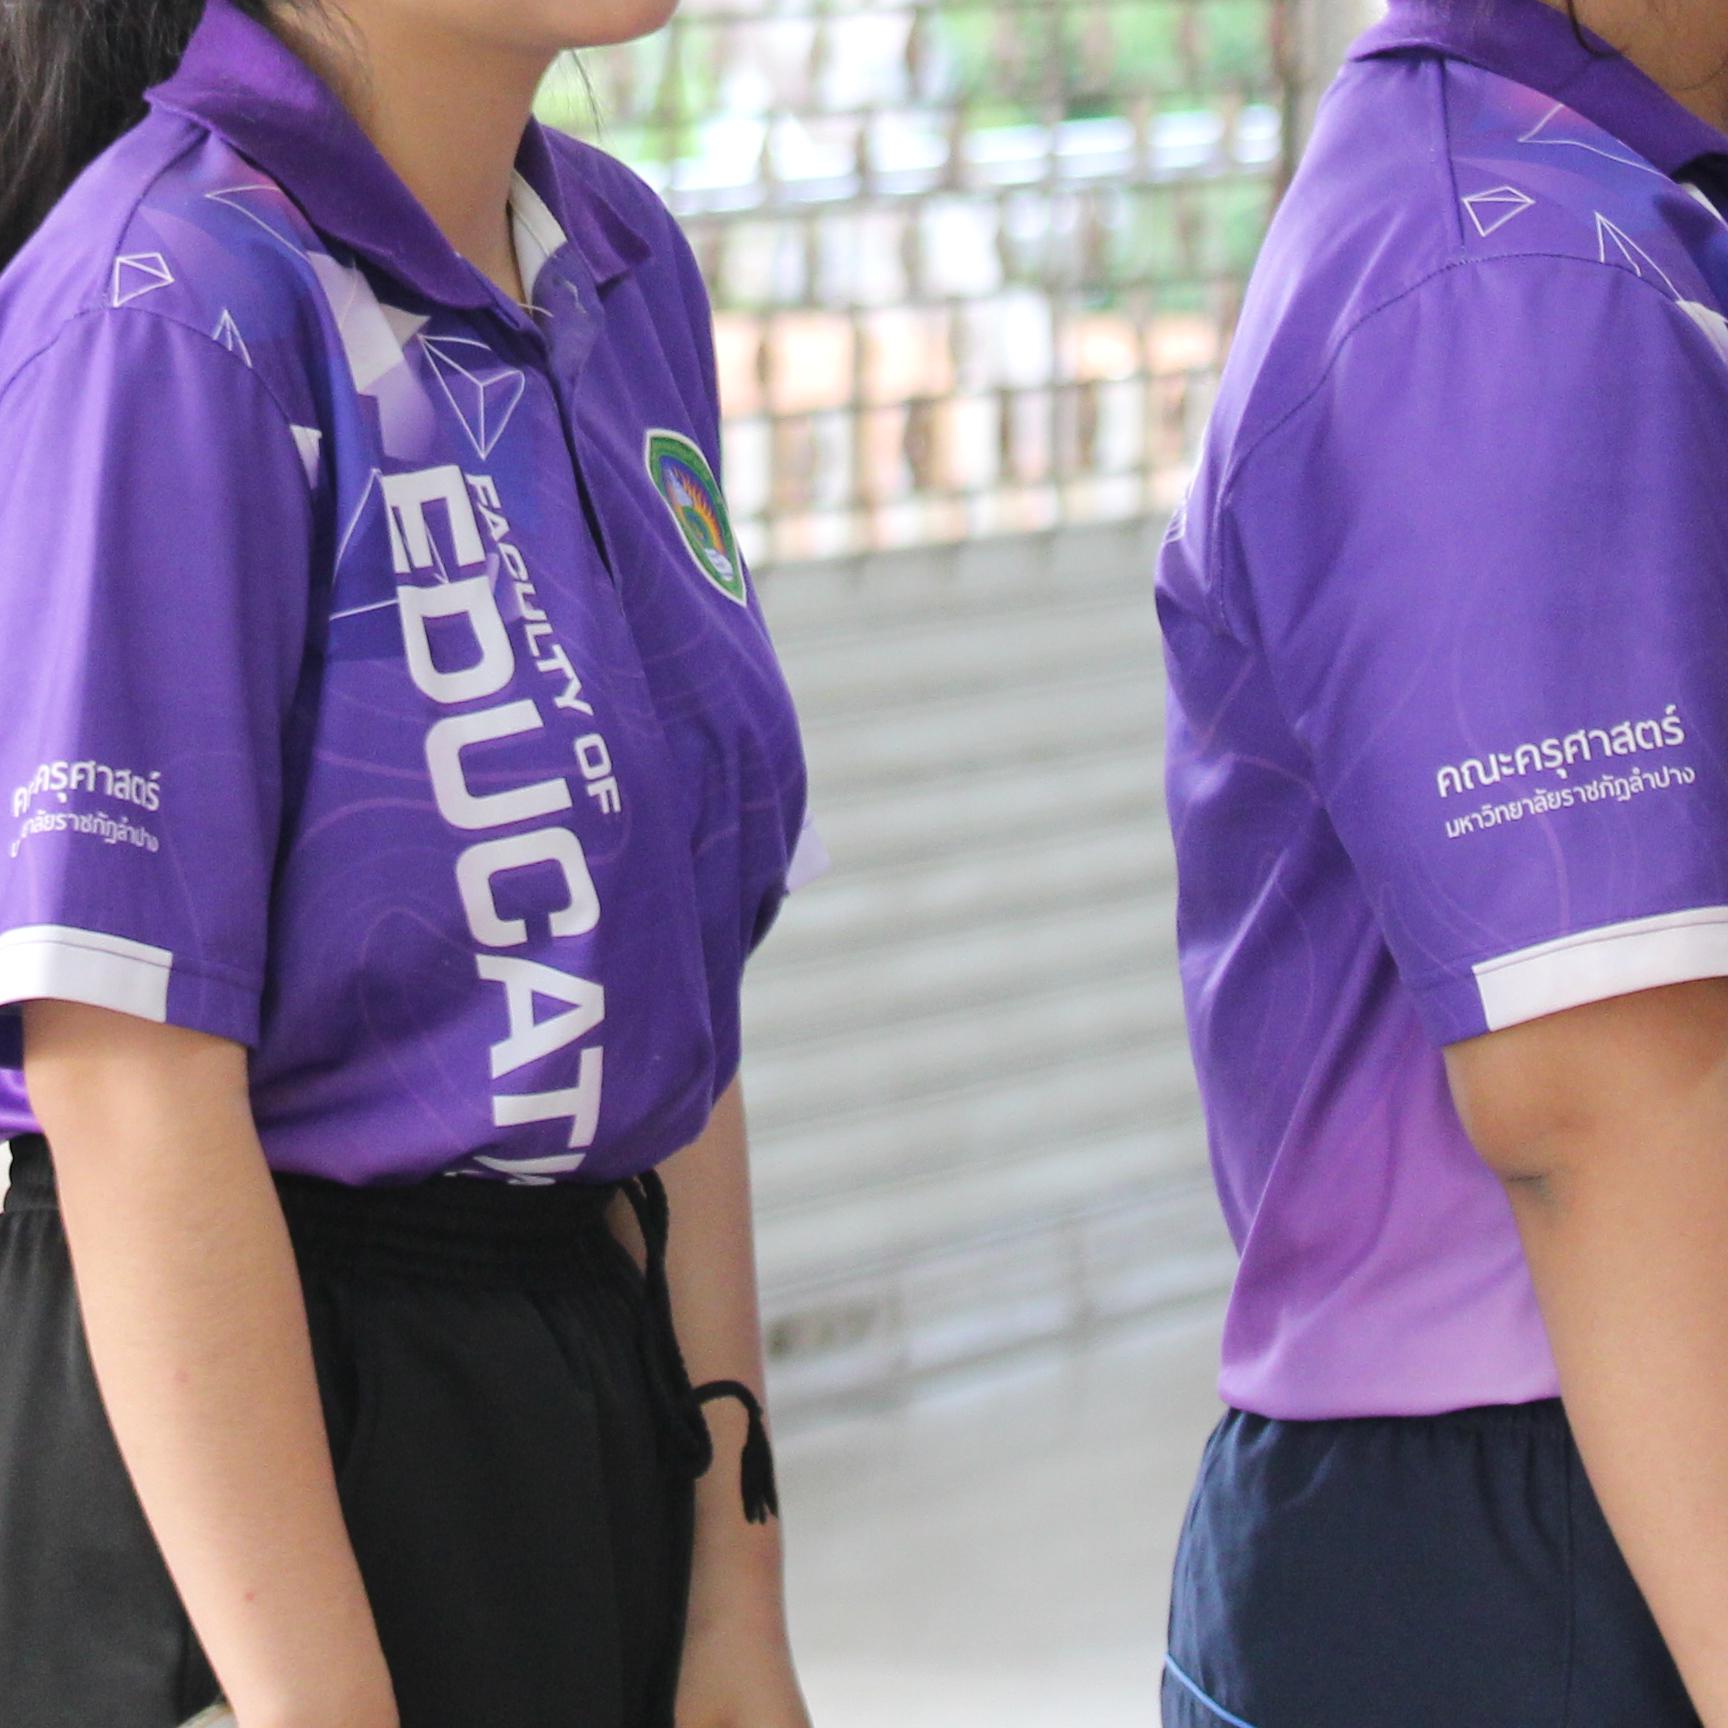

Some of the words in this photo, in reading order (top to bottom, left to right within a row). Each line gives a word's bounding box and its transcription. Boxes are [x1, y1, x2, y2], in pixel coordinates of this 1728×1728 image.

[466, 473, 595, 717] FACULTY
[573, 732, 622, 815] OF
[12, 759, 161, 818] คครุศาสตร์
[1436, 704, 1686, 799] คณะครุศาสตร์
[1445, 766, 1696, 840] มหาวิทยาลัยราชภัฏลำปาง
